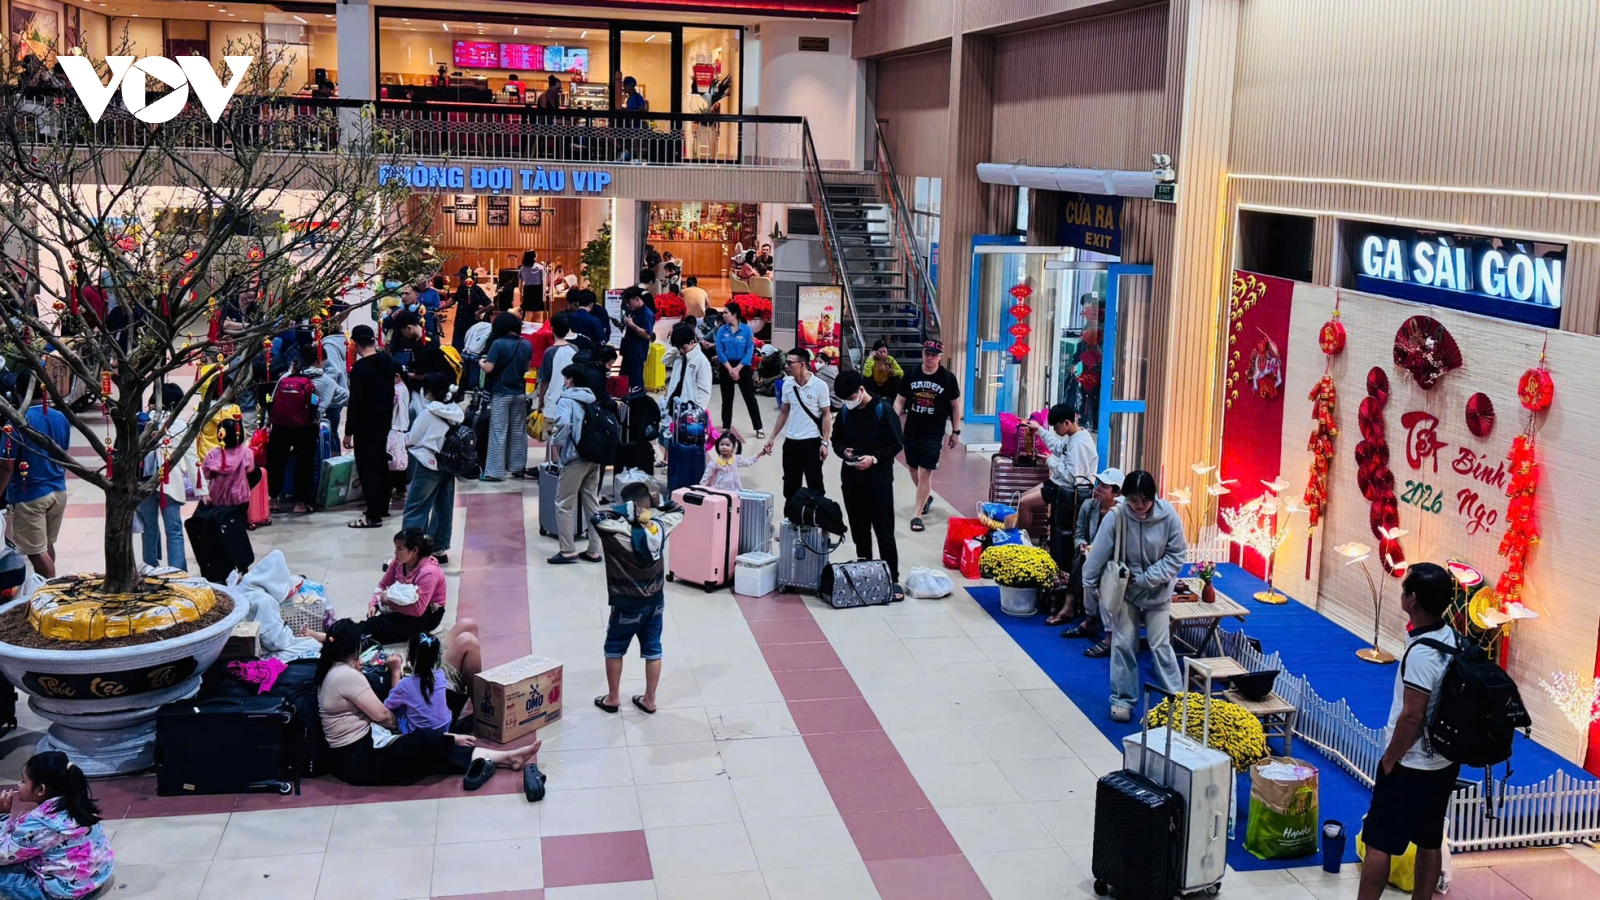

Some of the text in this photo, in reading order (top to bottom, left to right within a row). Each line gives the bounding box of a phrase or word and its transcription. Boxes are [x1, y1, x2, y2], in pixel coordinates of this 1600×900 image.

[471, 166, 512, 195] ĐỢI
[520, 165, 565, 191] TÀU
[572, 171, 611, 192] VIP
[1095, 204, 1114, 229] RA
[1085, 231, 1112, 249] EXIT
[1362, 235, 1562, 308] GA SÀI GÒN
[911, 403, 935, 414] LIFE
[1401, 411, 1448, 473] Tết
[1452, 446, 1507, 489] Bính
[1400, 480, 1444, 514] 2026
[1456, 488, 1498, 536] Ngọ
[526, 694, 544, 712] OMO
